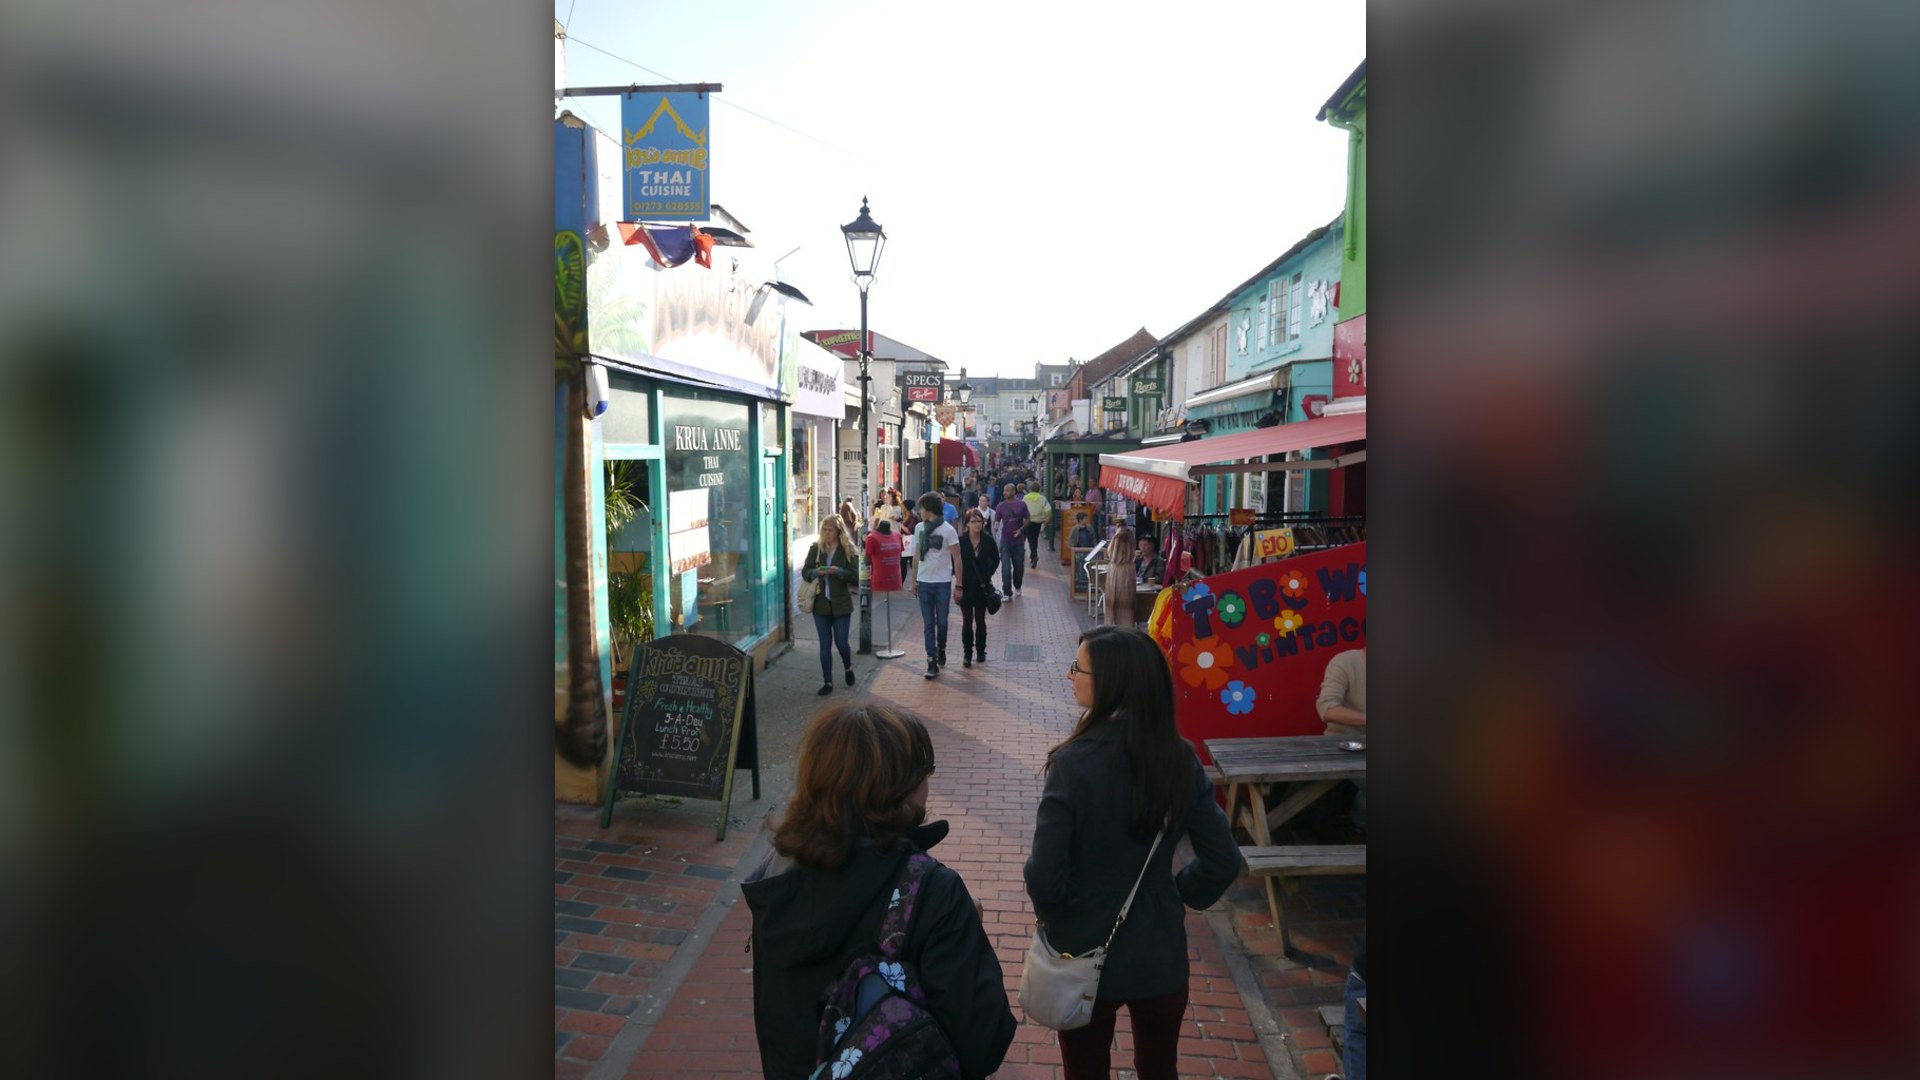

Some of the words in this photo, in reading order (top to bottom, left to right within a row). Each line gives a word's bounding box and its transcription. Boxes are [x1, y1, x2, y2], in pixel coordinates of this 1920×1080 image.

[640, 170, 691, 184] THAI
[641, 185, 691, 196] CUISINE
[906, 375, 941, 386] SPECS
[675, 425, 708, 451] KRUA
[713, 428, 741, 451] ANNE
[703, 455, 719, 470] THAI
[699, 472, 725, 487] CUISINE
[1262, 535, 1288, 556] £10
[1317, 562, 1366, 603] W
[653, 697, 678, 710] Fresh
[686, 700, 713, 719] Healthy
[655, 721, 679, 734] Lunch
[660, 733, 701, 752] £5.50
